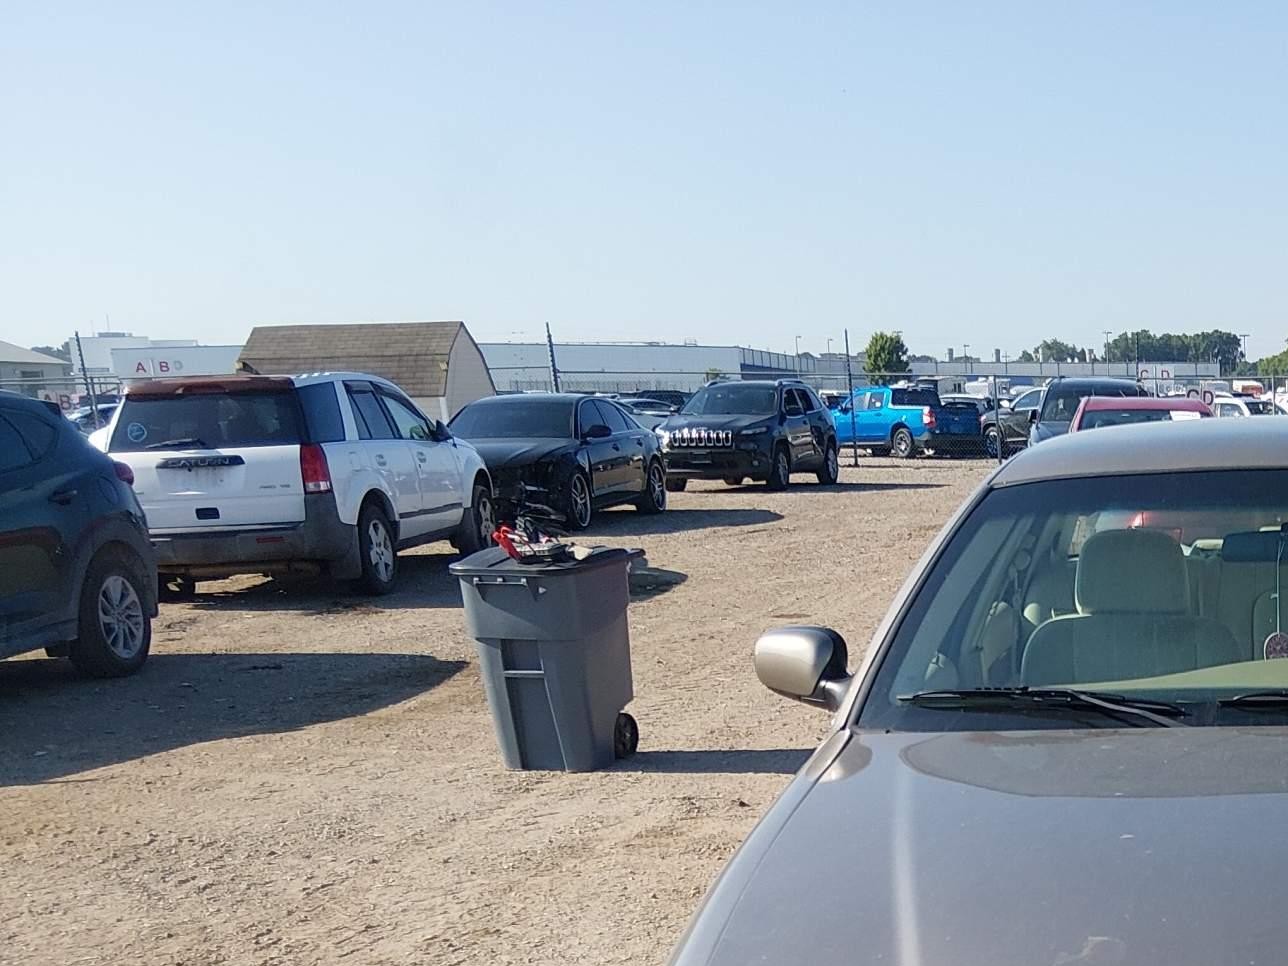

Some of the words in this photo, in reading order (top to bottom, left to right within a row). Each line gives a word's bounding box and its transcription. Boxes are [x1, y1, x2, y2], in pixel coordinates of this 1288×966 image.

[135, 361, 147, 373] A
[159, 361, 170, 373] B
[59, 394, 72, 410] B
[1202, 389, 1215, 406] D
[167, 457, 230, 468] SATURN
